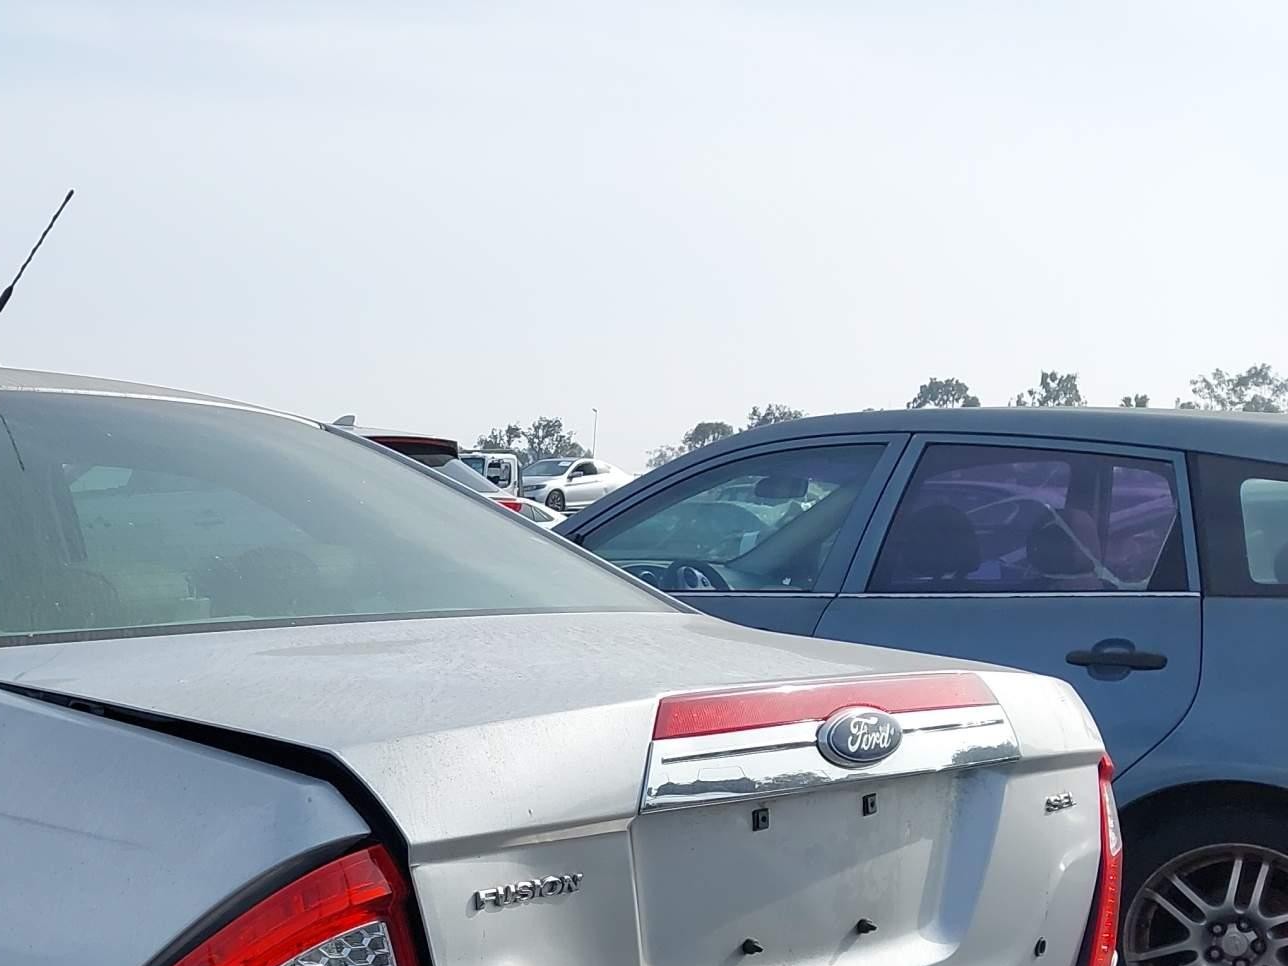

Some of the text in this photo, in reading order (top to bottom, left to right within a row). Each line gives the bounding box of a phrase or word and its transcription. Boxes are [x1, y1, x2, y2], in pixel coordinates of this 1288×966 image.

[847, 716, 892, 753] Ford
[1044, 792, 1077, 813] SEL
[472, 873, 583, 911] FUSION
